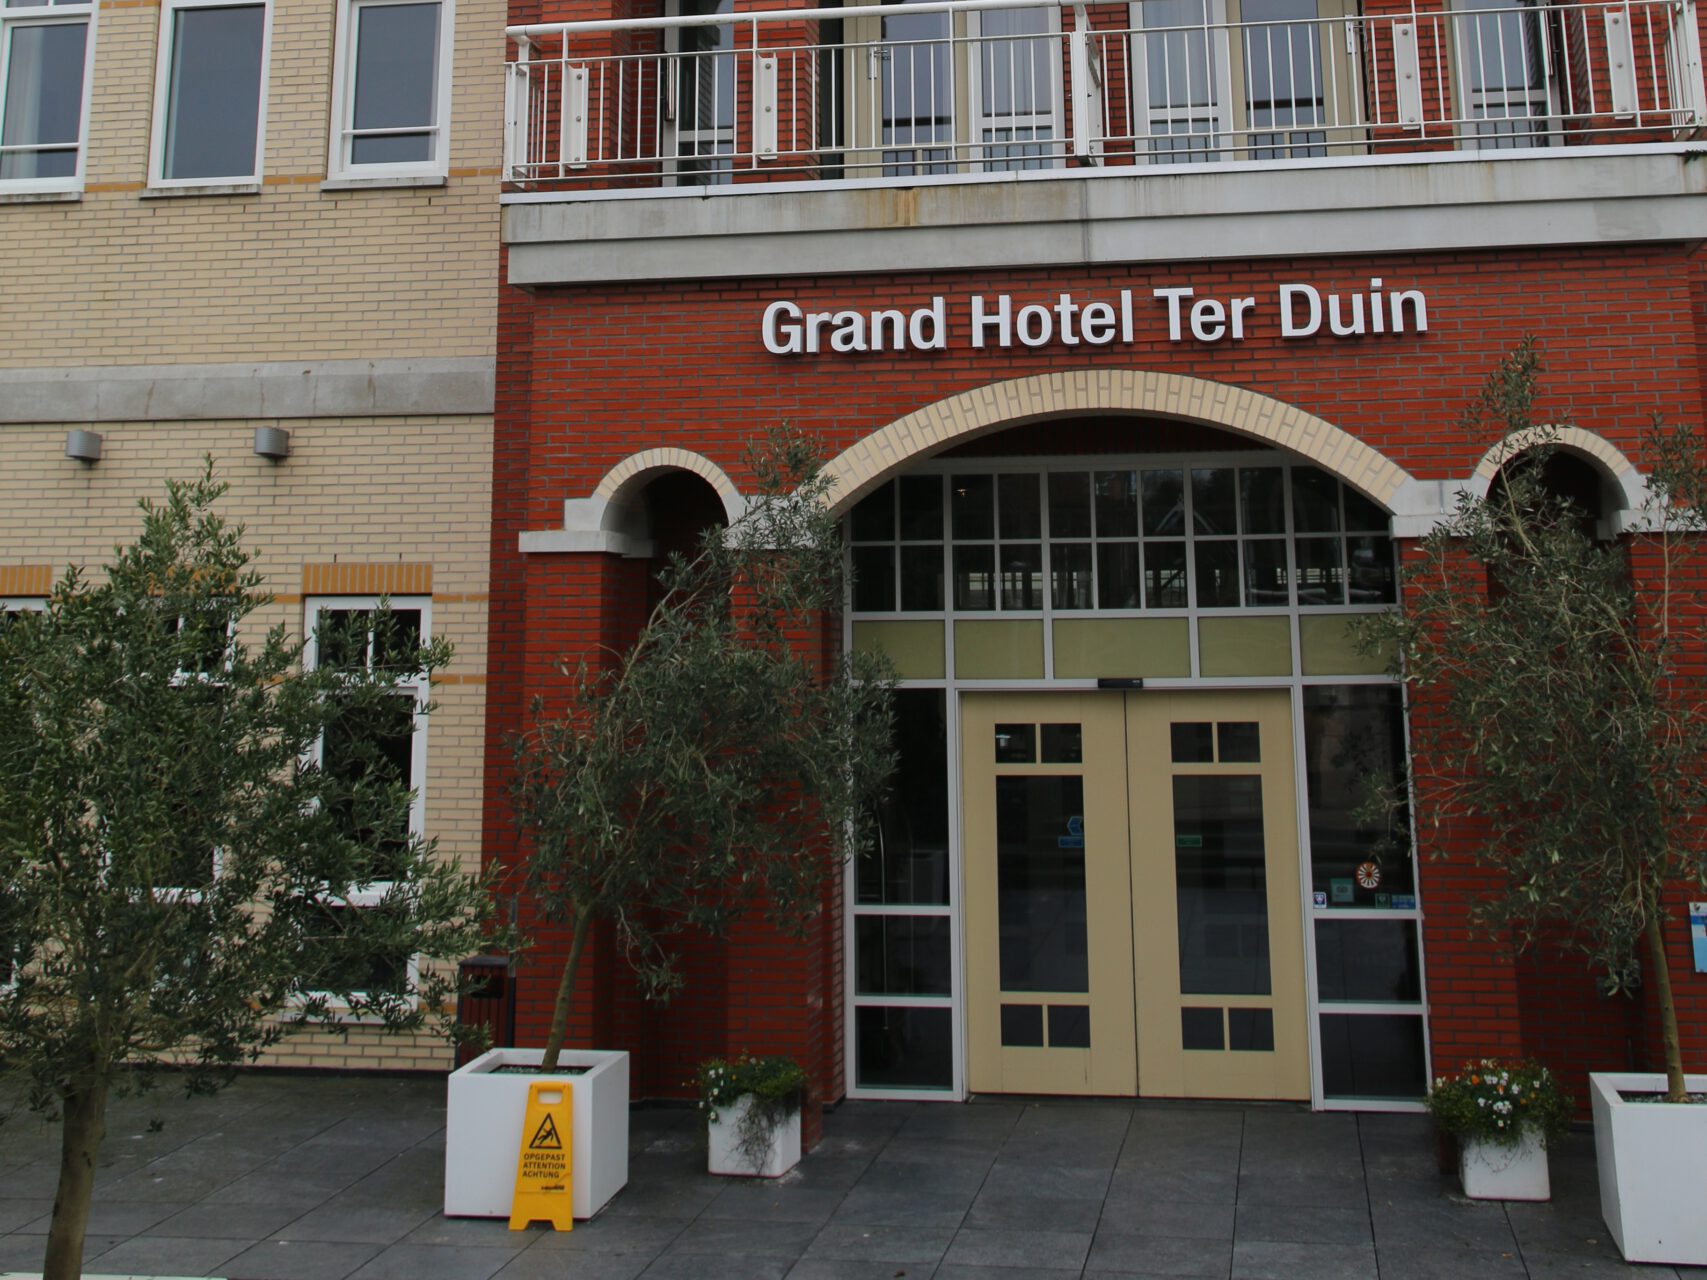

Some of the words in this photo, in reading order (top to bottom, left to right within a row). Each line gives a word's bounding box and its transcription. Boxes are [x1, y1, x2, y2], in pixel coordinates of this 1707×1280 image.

[761, 295, 946, 355] Grand
[971, 289, 1134, 349] Hotel
[1153, 287, 1256, 344] Ter
[1279, 277, 1428, 339] Duin
[523, 1153, 565, 1161] OPGEPAST
[523, 1161, 566, 1169] ATTENTION
[522, 1170, 560, 1178] ACHTUNG
